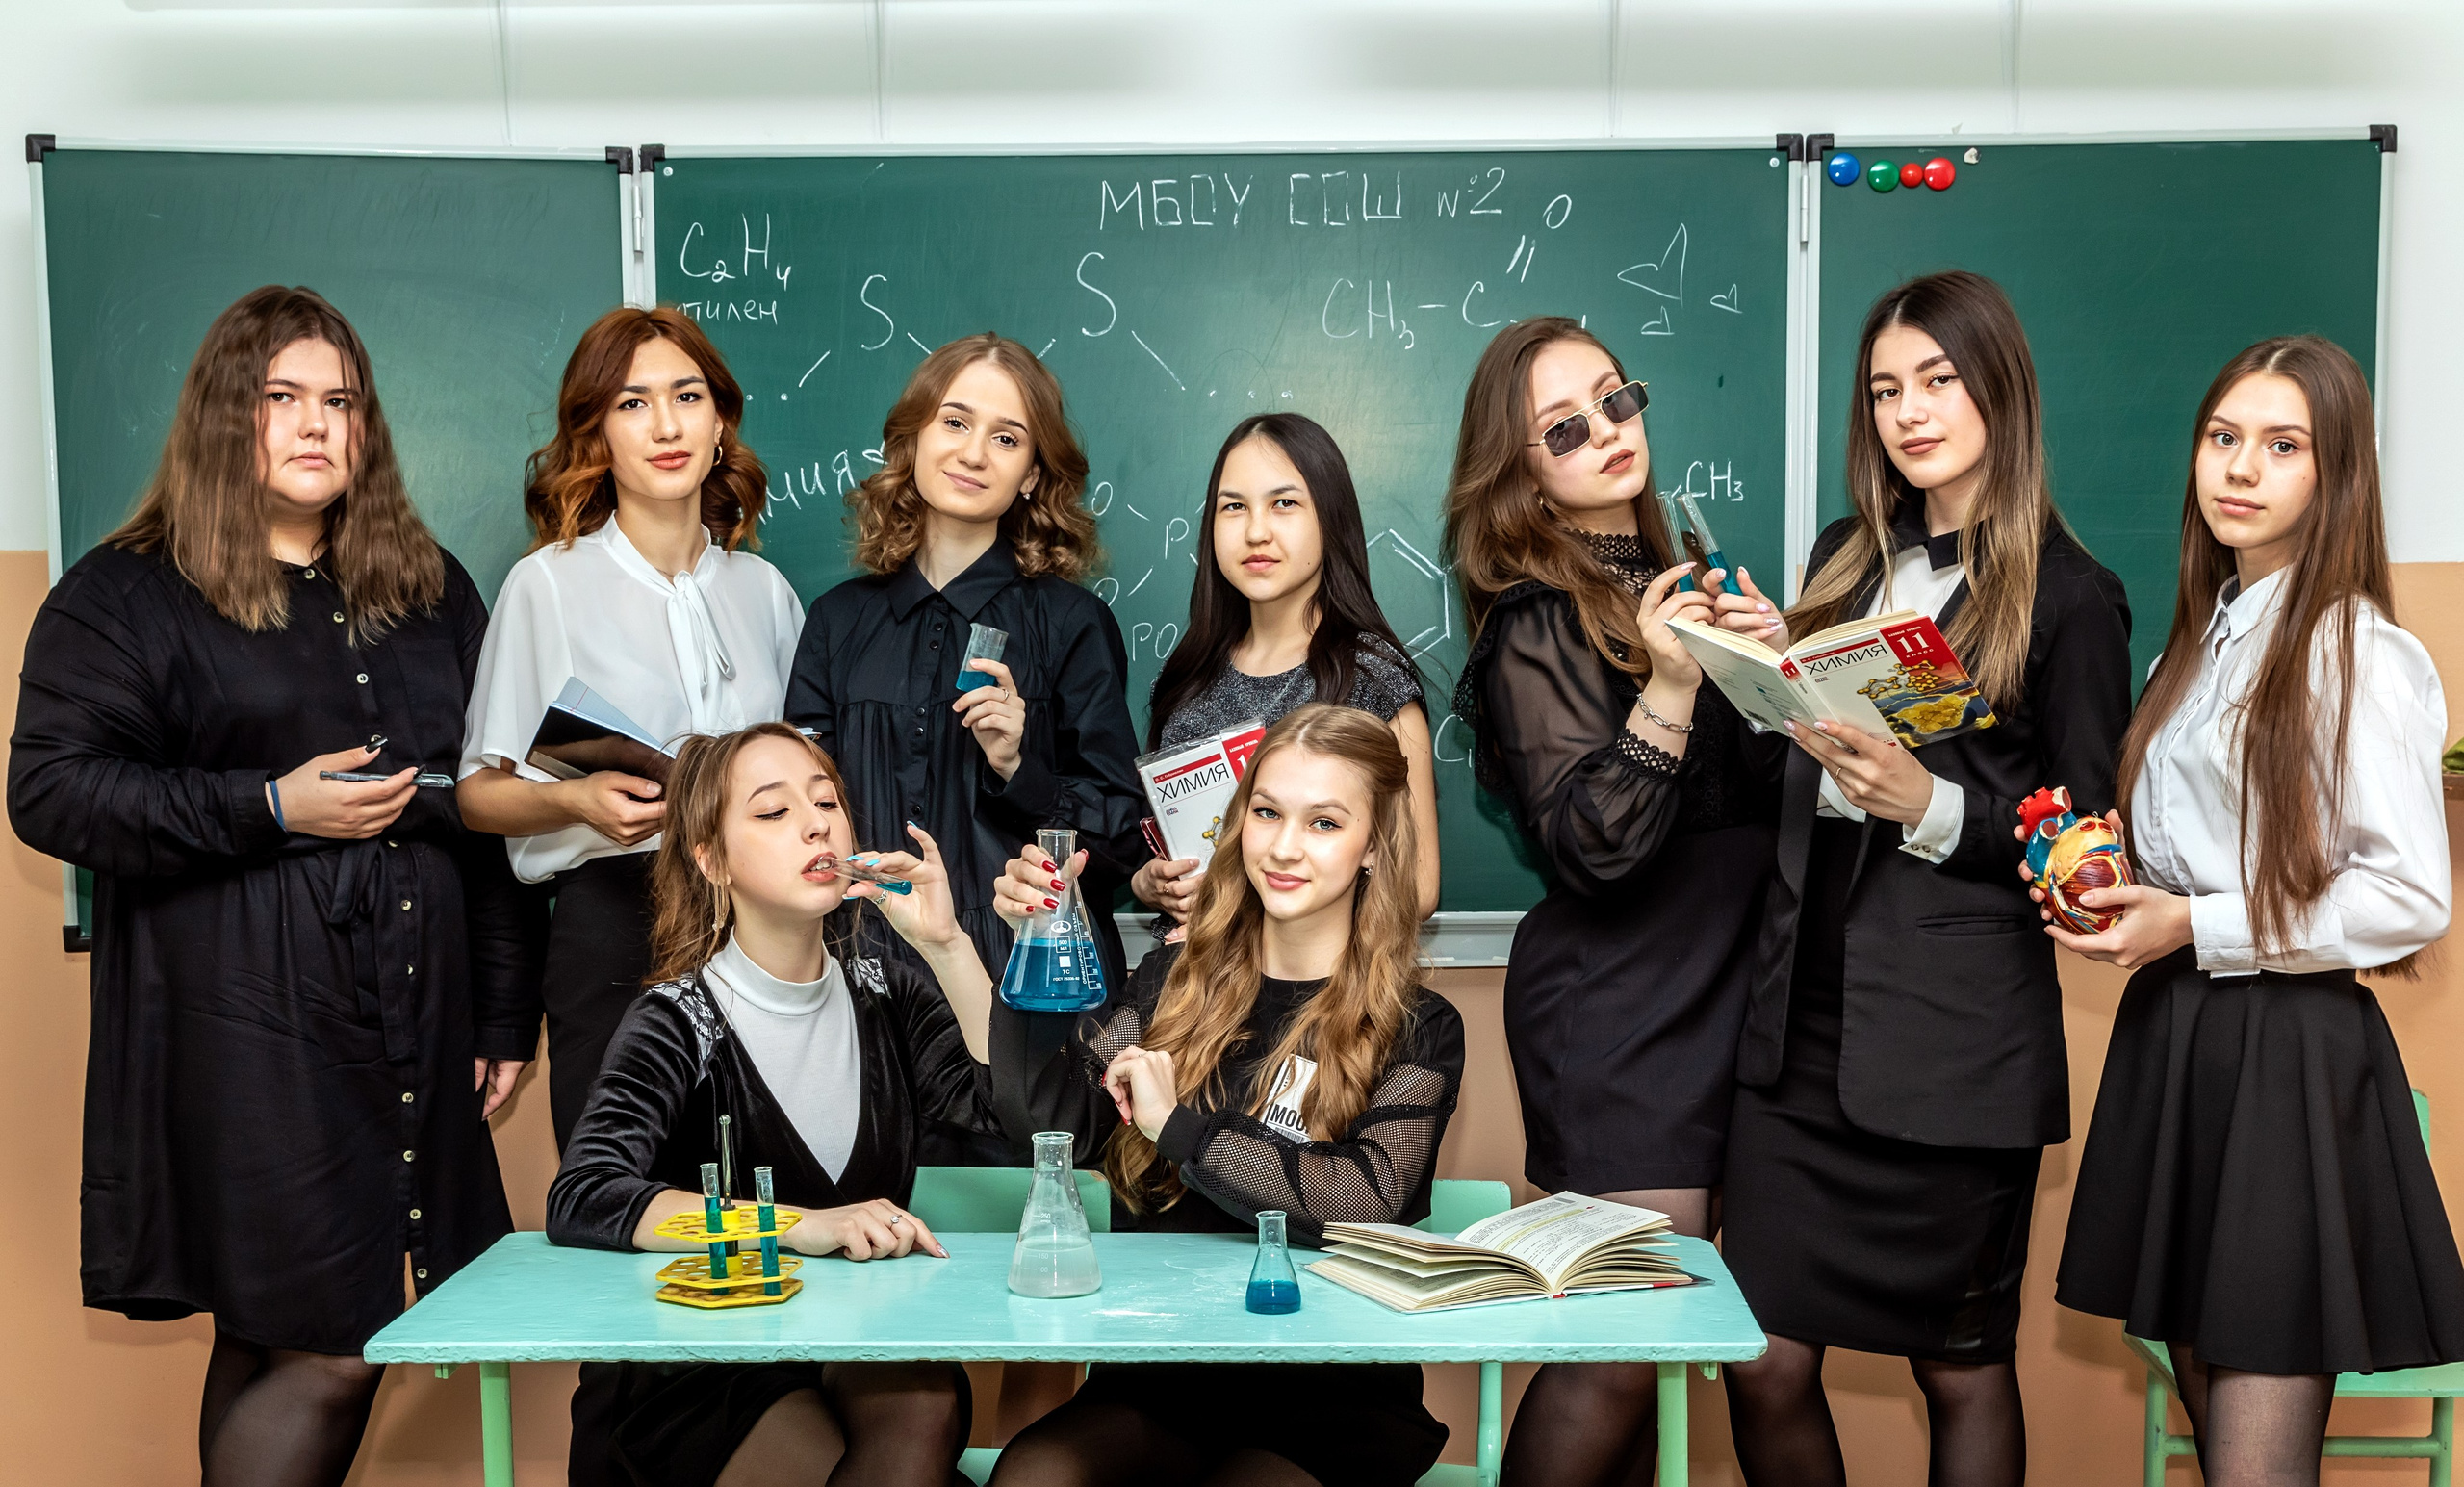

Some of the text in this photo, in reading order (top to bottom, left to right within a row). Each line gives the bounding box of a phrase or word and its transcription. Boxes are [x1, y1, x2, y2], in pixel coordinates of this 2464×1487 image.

[1099, 173, 1253, 231] МБОУ
[1075, 251, 1117, 337] S
[860, 274, 895, 351] S
[1165, 517, 1190, 560] P
[1804, 644, 1888, 676] ХИМИЯ
[1897, 631, 1930, 654] 11
[1784, 667, 1797, 677] 11
[1237, 751, 1255, 771] 1
[1157, 763, 1230, 803] ХИМИЯ
[1270, 1104, 1309, 1135] MOO
